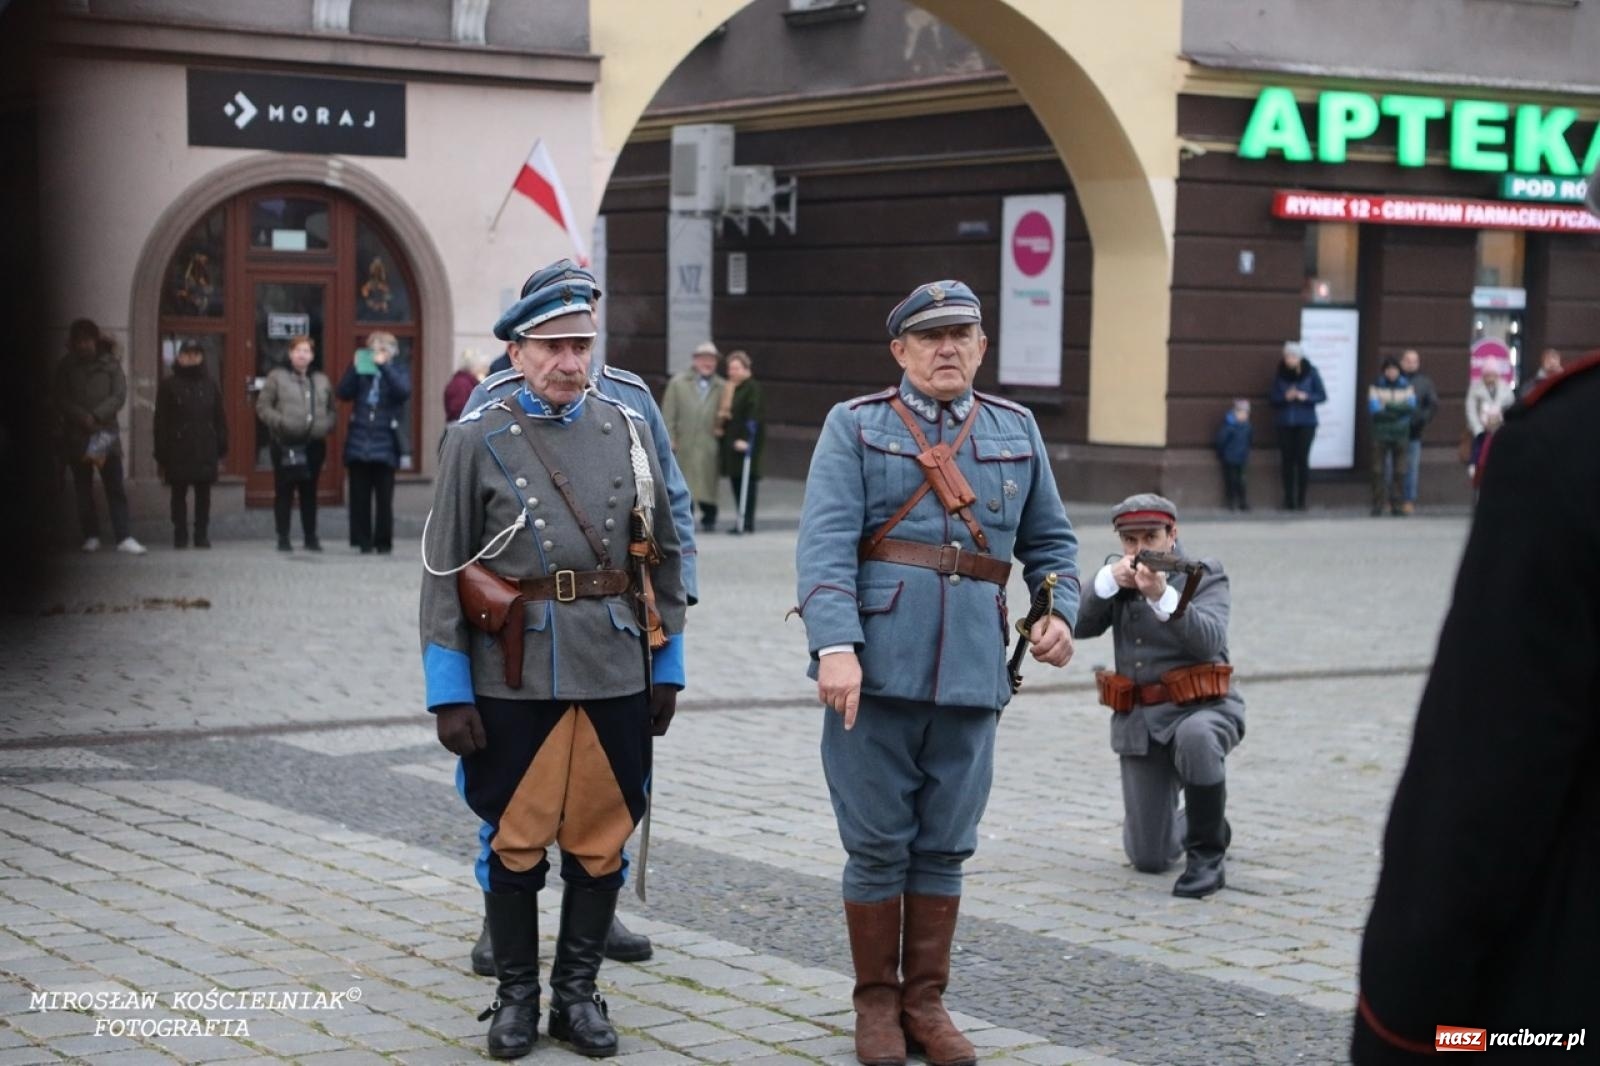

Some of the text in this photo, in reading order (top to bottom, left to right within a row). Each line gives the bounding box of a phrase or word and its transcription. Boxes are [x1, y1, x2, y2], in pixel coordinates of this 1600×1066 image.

[268, 104, 376, 128] MORAJ
[1238, 86, 1600, 175] APTEK
[1512, 178, 1588, 200] POD RÓ
[1285, 195, 1346, 217] RYNEK
[1350, 199, 1370, 218] 12
[1381, 200, 1463, 222] CENTRUM
